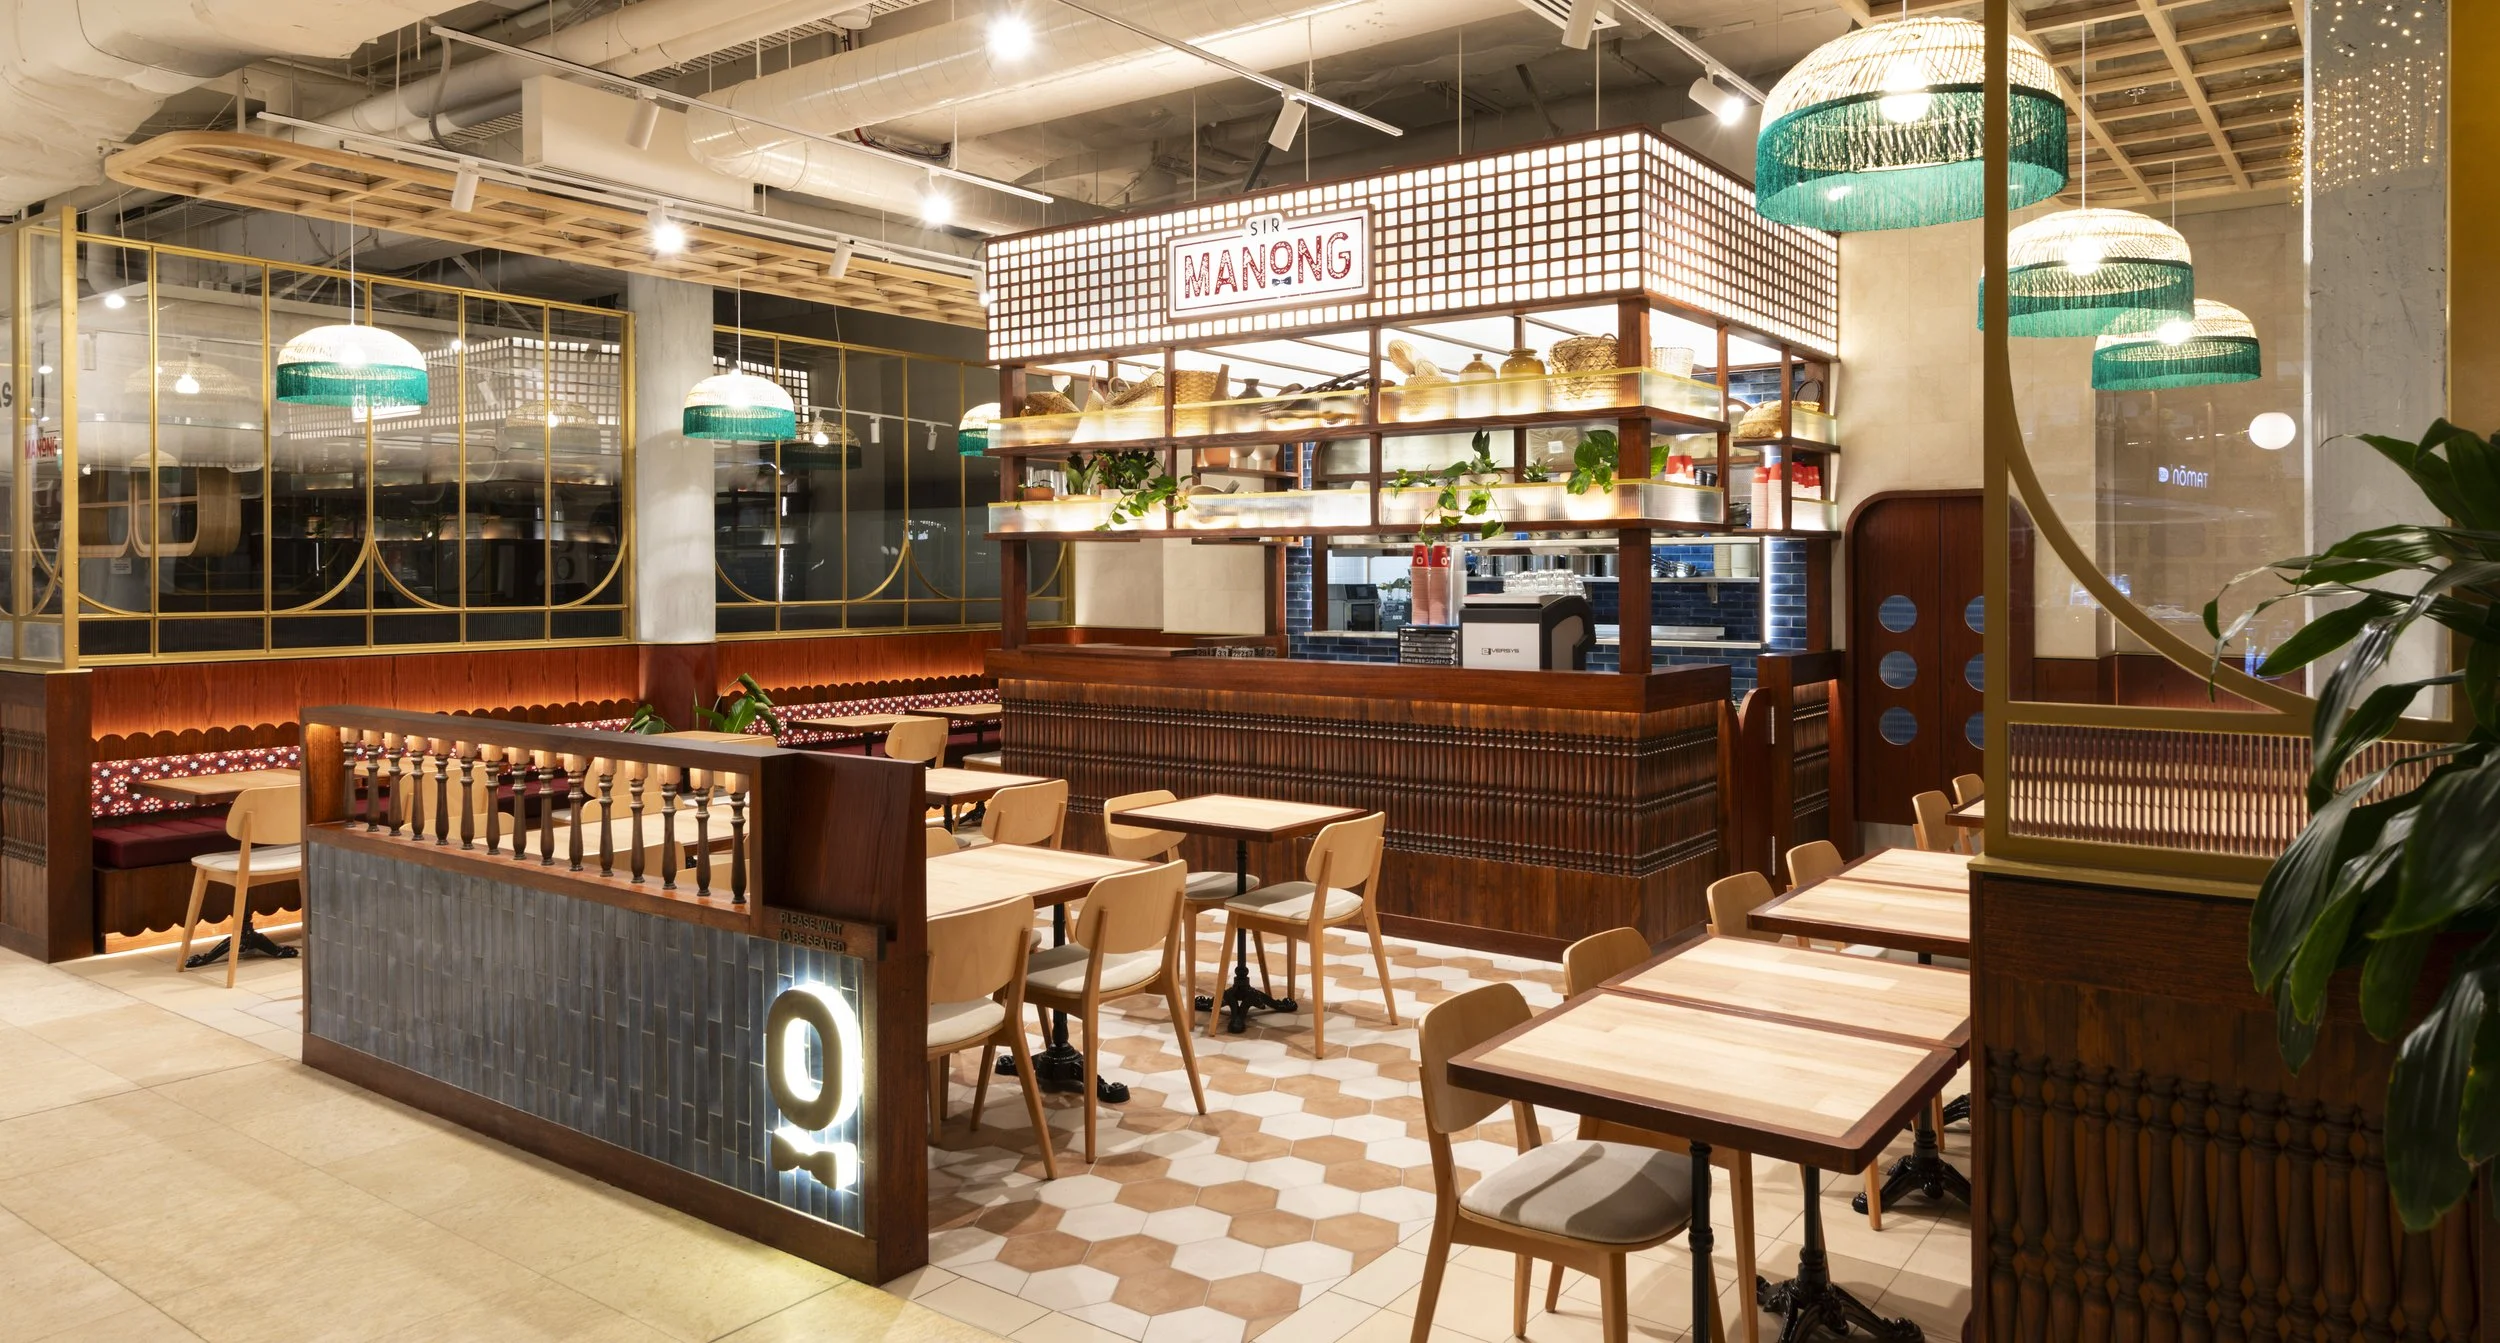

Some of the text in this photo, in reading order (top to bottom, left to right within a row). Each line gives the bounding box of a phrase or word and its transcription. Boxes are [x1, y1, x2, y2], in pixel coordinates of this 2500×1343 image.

[1250, 217, 1280, 236] SIR
[1184, 231, 1351, 299] MANONG
[780, 912, 842, 936] PLEASE WAIT
[778, 929, 845, 952] TO BE SEATED
